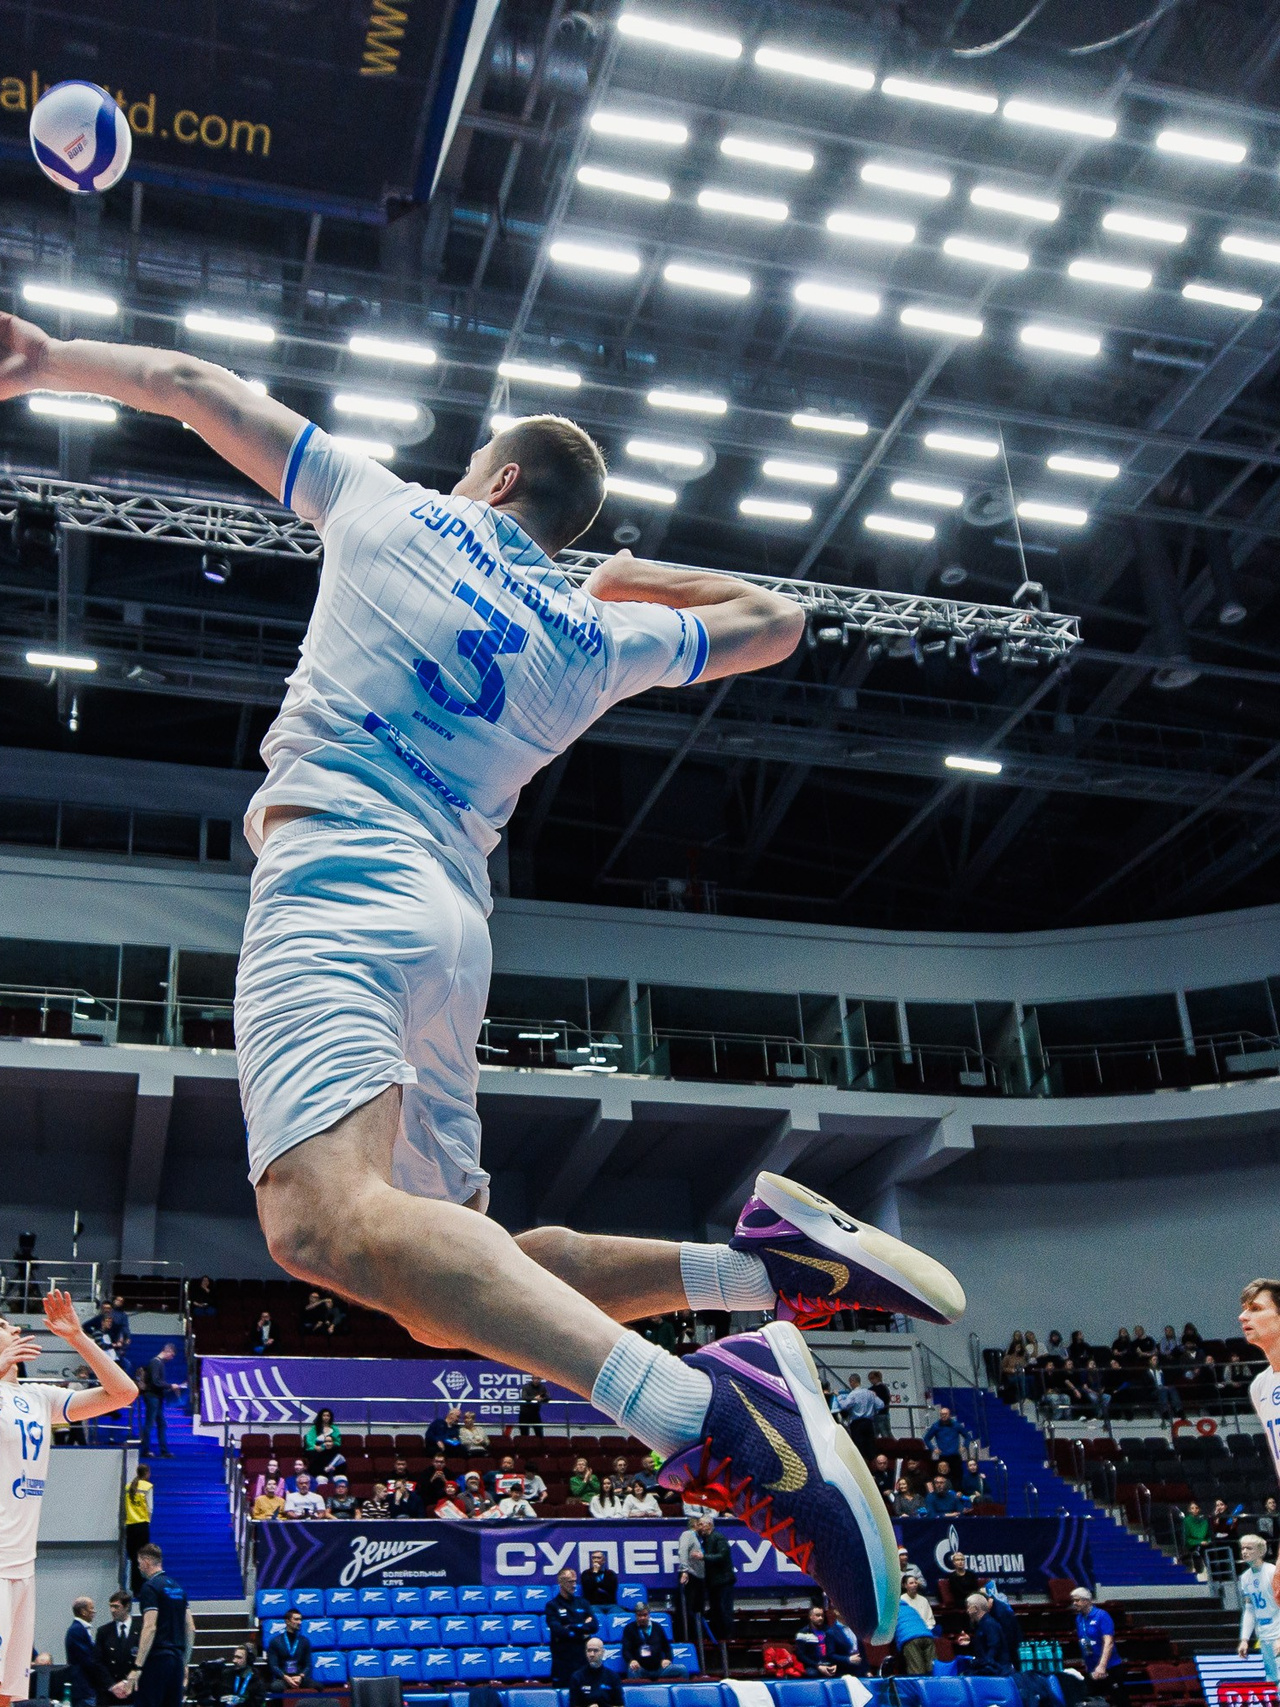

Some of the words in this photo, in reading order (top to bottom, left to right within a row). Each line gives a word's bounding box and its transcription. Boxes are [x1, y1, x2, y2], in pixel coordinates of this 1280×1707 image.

[413, 577, 530, 724] 3
[412, 711, 455, 741] ENSEN
[480, 1405, 520, 1415] 2025
[14, 1418, 44, 1461] 19
[382, 1569, 447, 1579] ВОЛЕЙБОЛЬНЫЙ
[382, 1579, 404, 1587] КЛУБ
